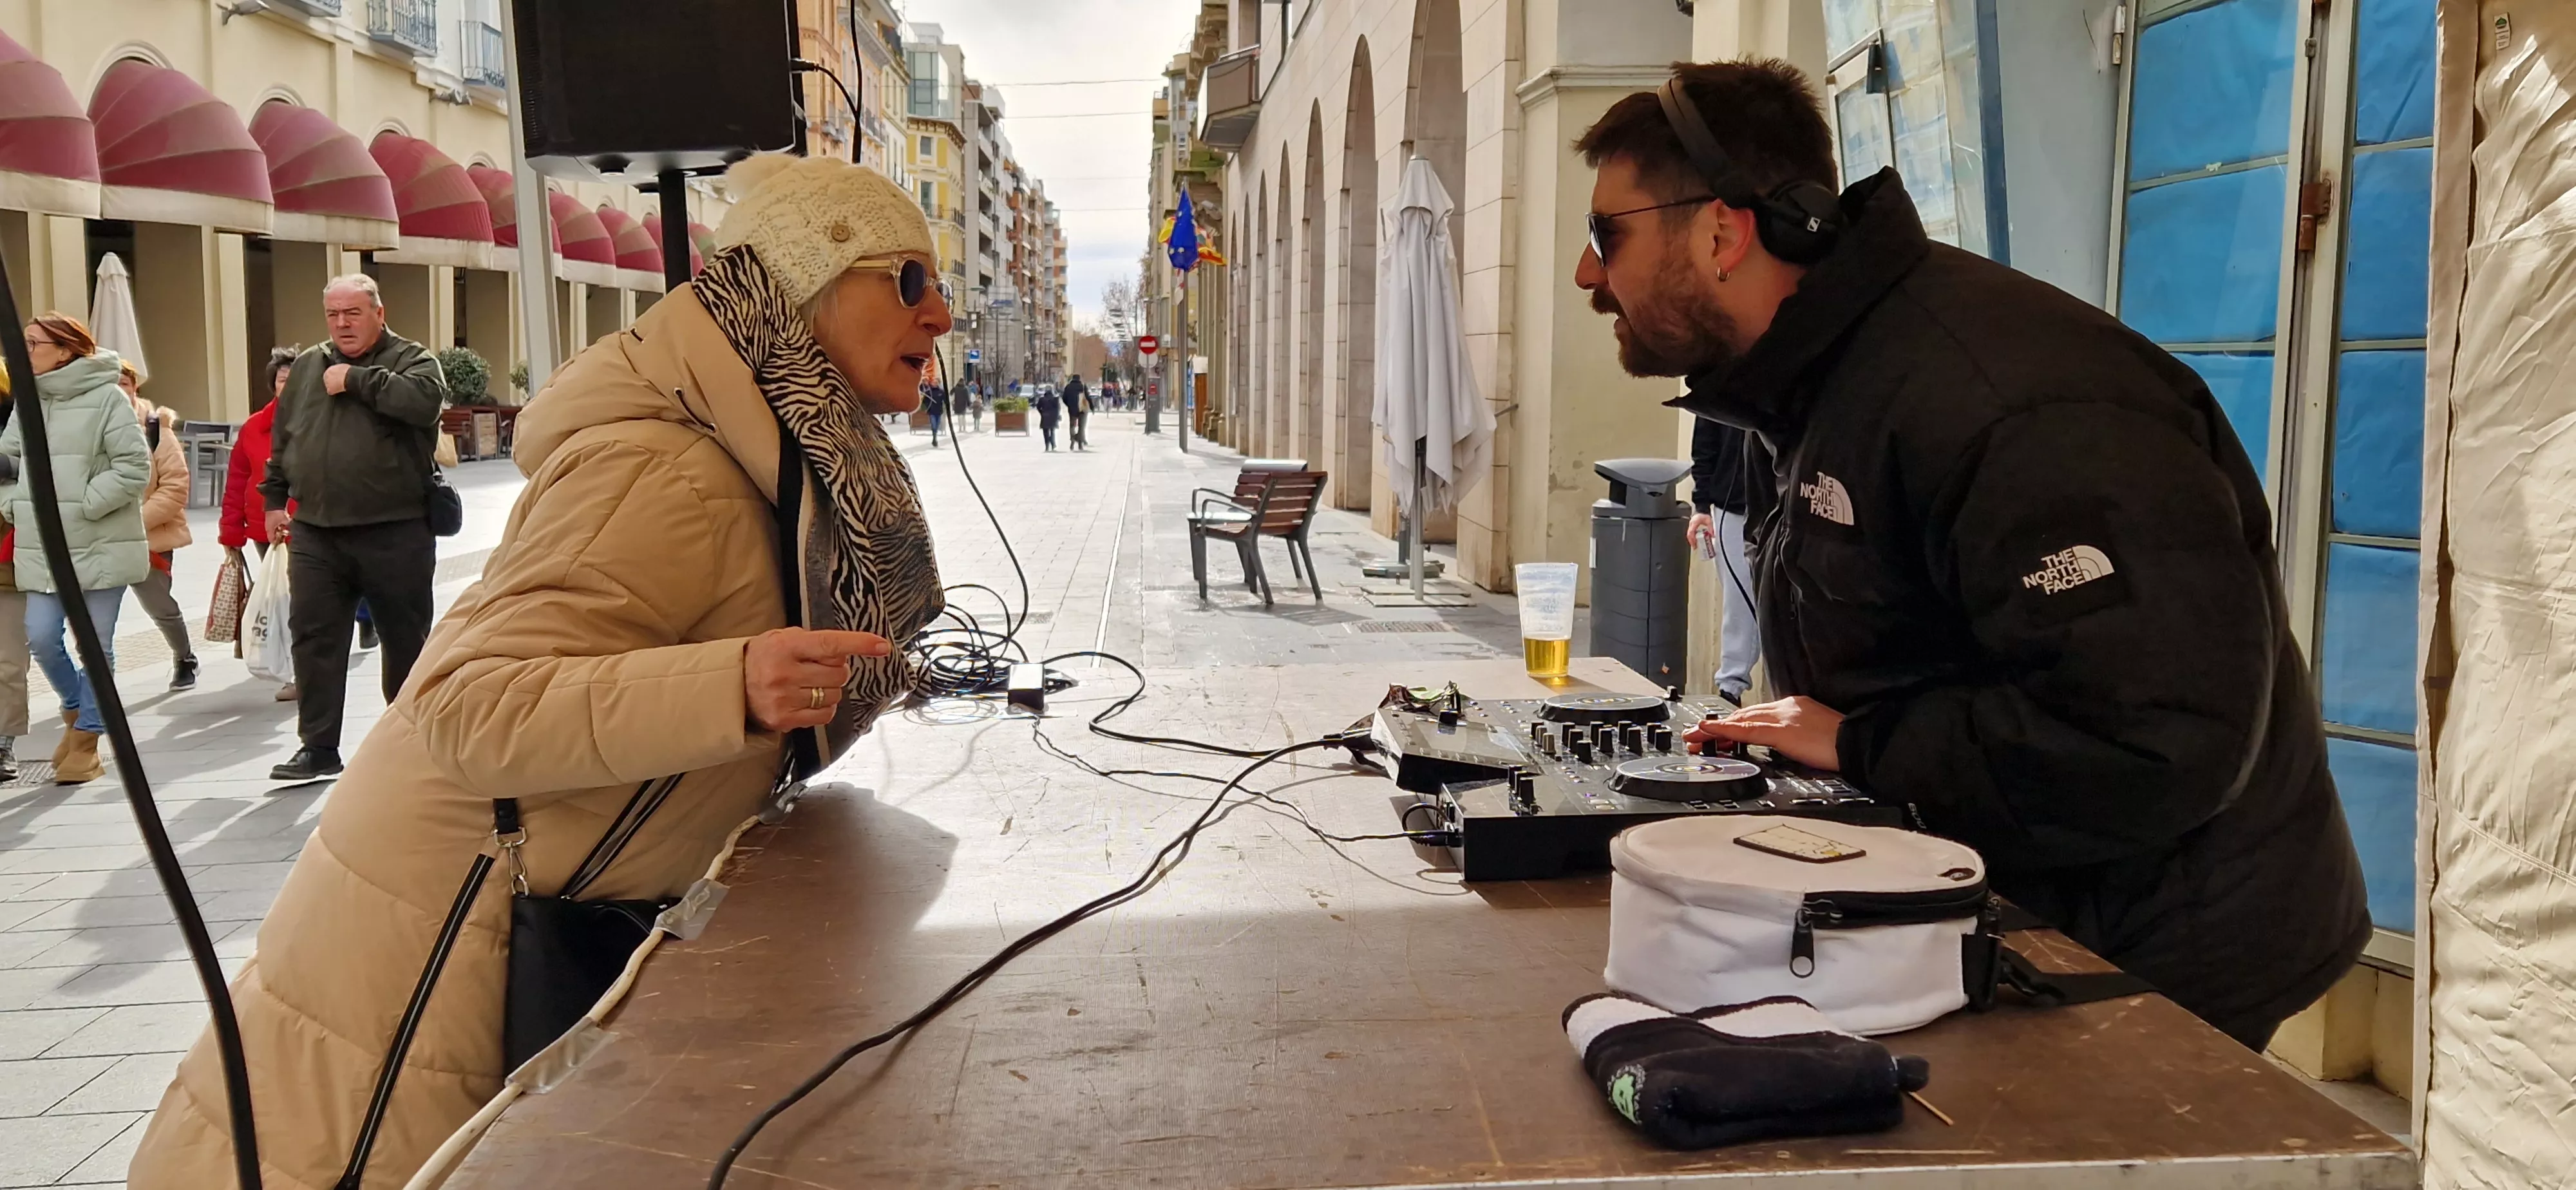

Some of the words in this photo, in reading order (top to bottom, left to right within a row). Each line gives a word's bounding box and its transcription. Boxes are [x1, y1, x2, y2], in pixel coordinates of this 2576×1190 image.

[1817, 471, 1833, 491] THE
[1800, 482, 1834, 506] NORTH
[1810, 500, 1834, 520] FACE
[2041, 548, 2076, 568] THE
[2022, 560, 2080, 589] NORTH
[2043, 572, 2086, 595] FACE
